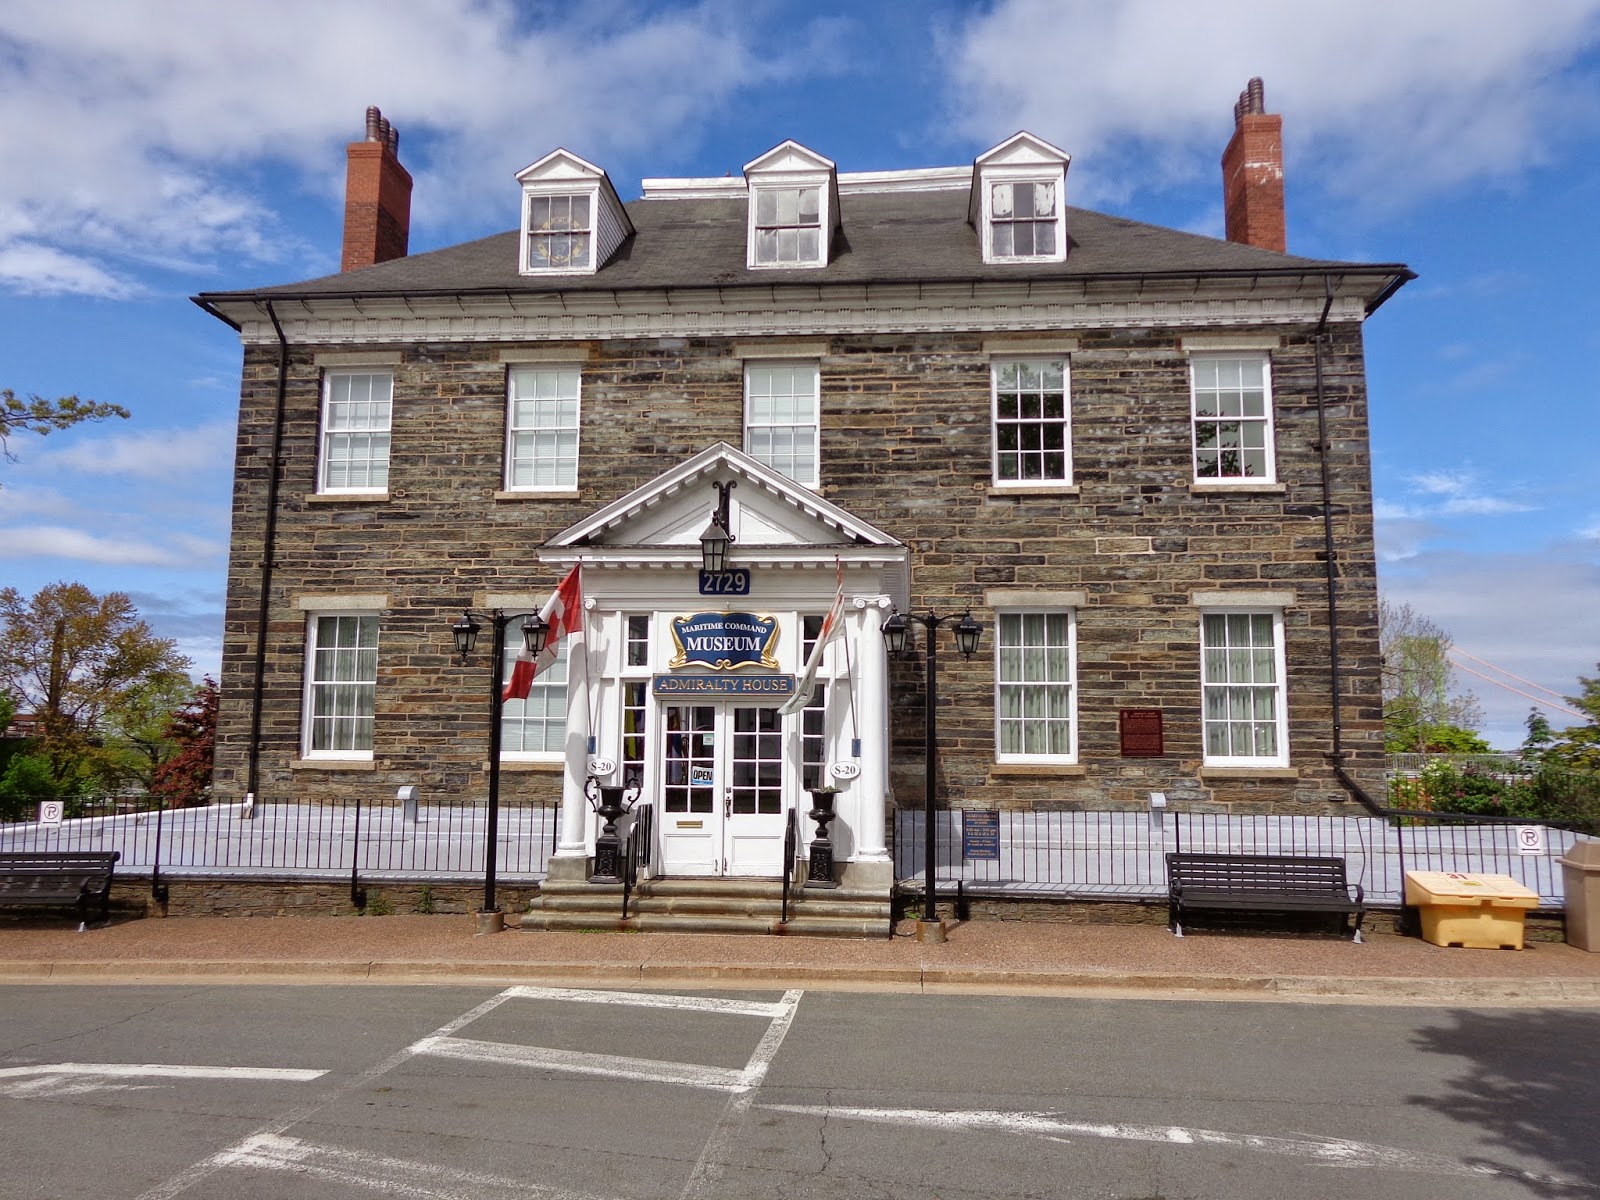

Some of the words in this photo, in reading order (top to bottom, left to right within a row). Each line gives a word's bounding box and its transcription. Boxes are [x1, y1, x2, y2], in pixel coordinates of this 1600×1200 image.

[703, 572, 746, 592] 2729
[681, 622, 724, 634] MARITIME
[724, 622, 767, 634] COMMAND
[686, 636, 761, 651] MUSEUM
[658, 678, 738, 691] ADMIRALTY
[742, 679, 788, 691] HOUSE
[590, 761, 612, 771] S-20
[834, 765, 856, 775] S-20
[693, 769, 713, 781] OPEN
